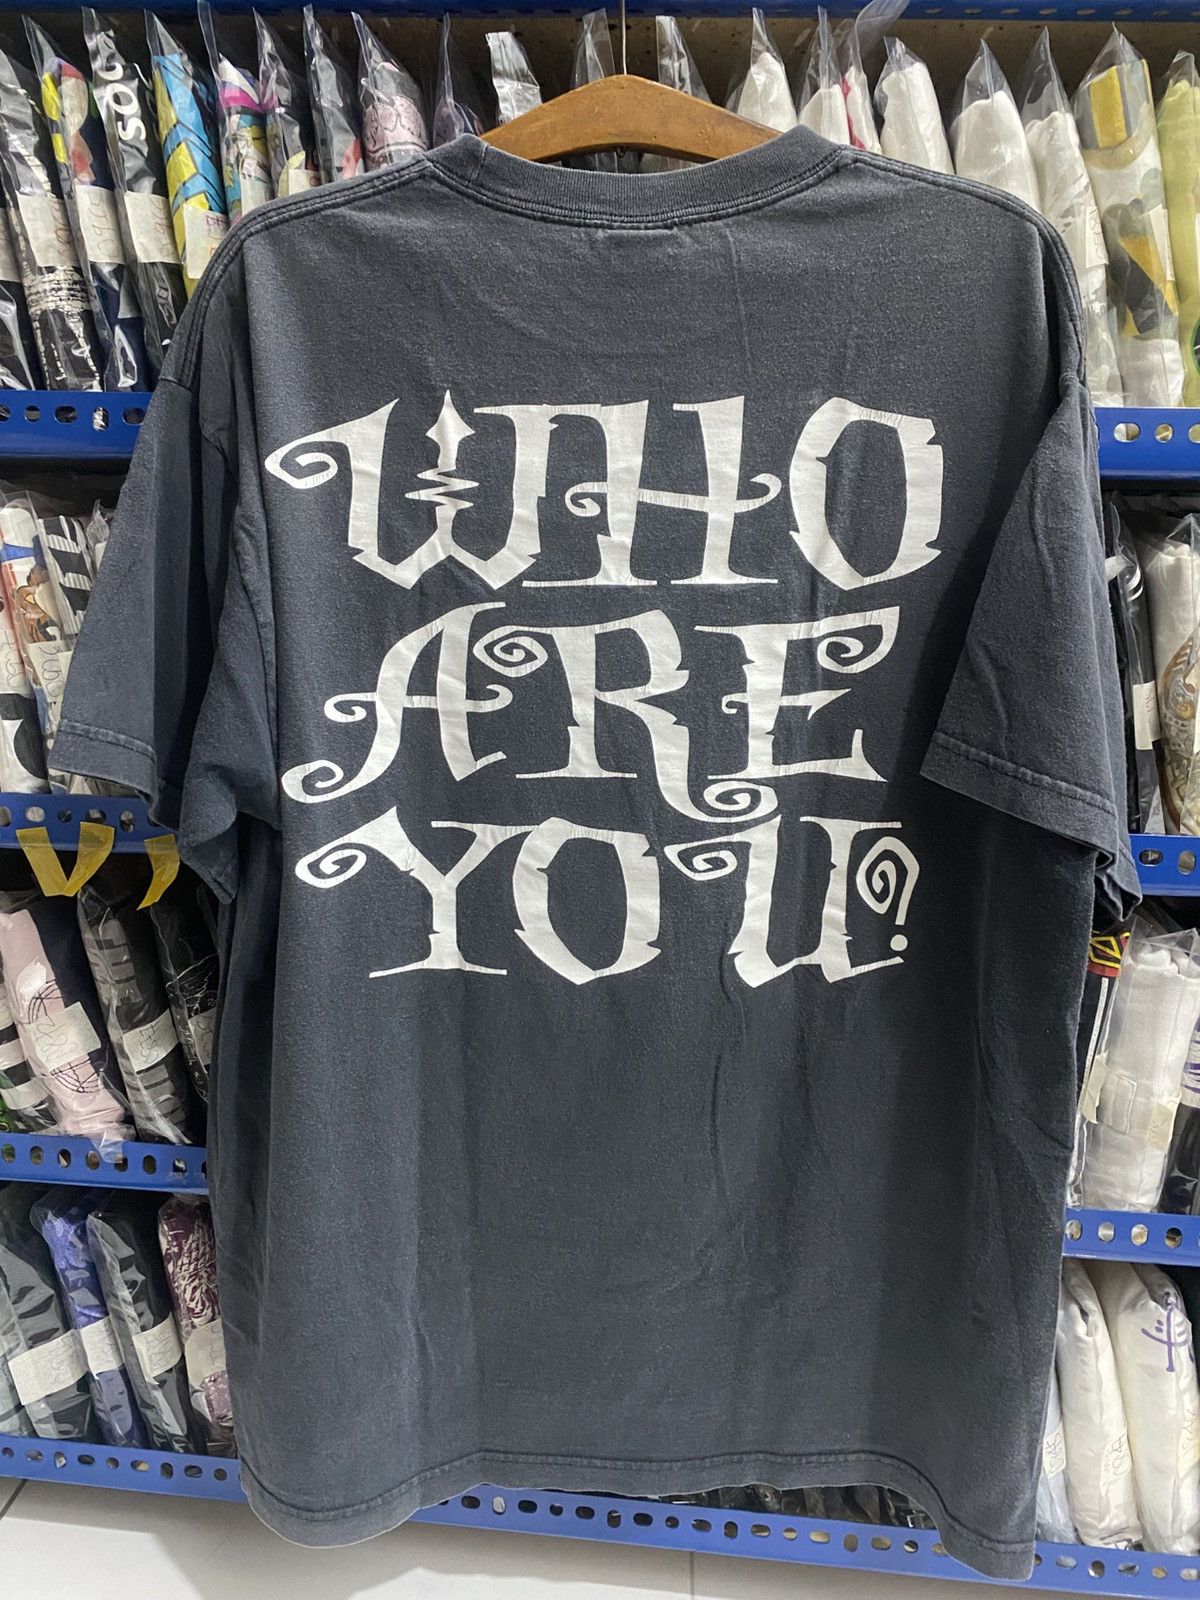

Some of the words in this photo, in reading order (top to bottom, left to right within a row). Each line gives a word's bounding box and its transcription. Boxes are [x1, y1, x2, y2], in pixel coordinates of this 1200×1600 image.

[265, 390, 943, 590] WHO
[281, 602, 901, 823] ARE
[293, 807, 920, 988] YOU?
